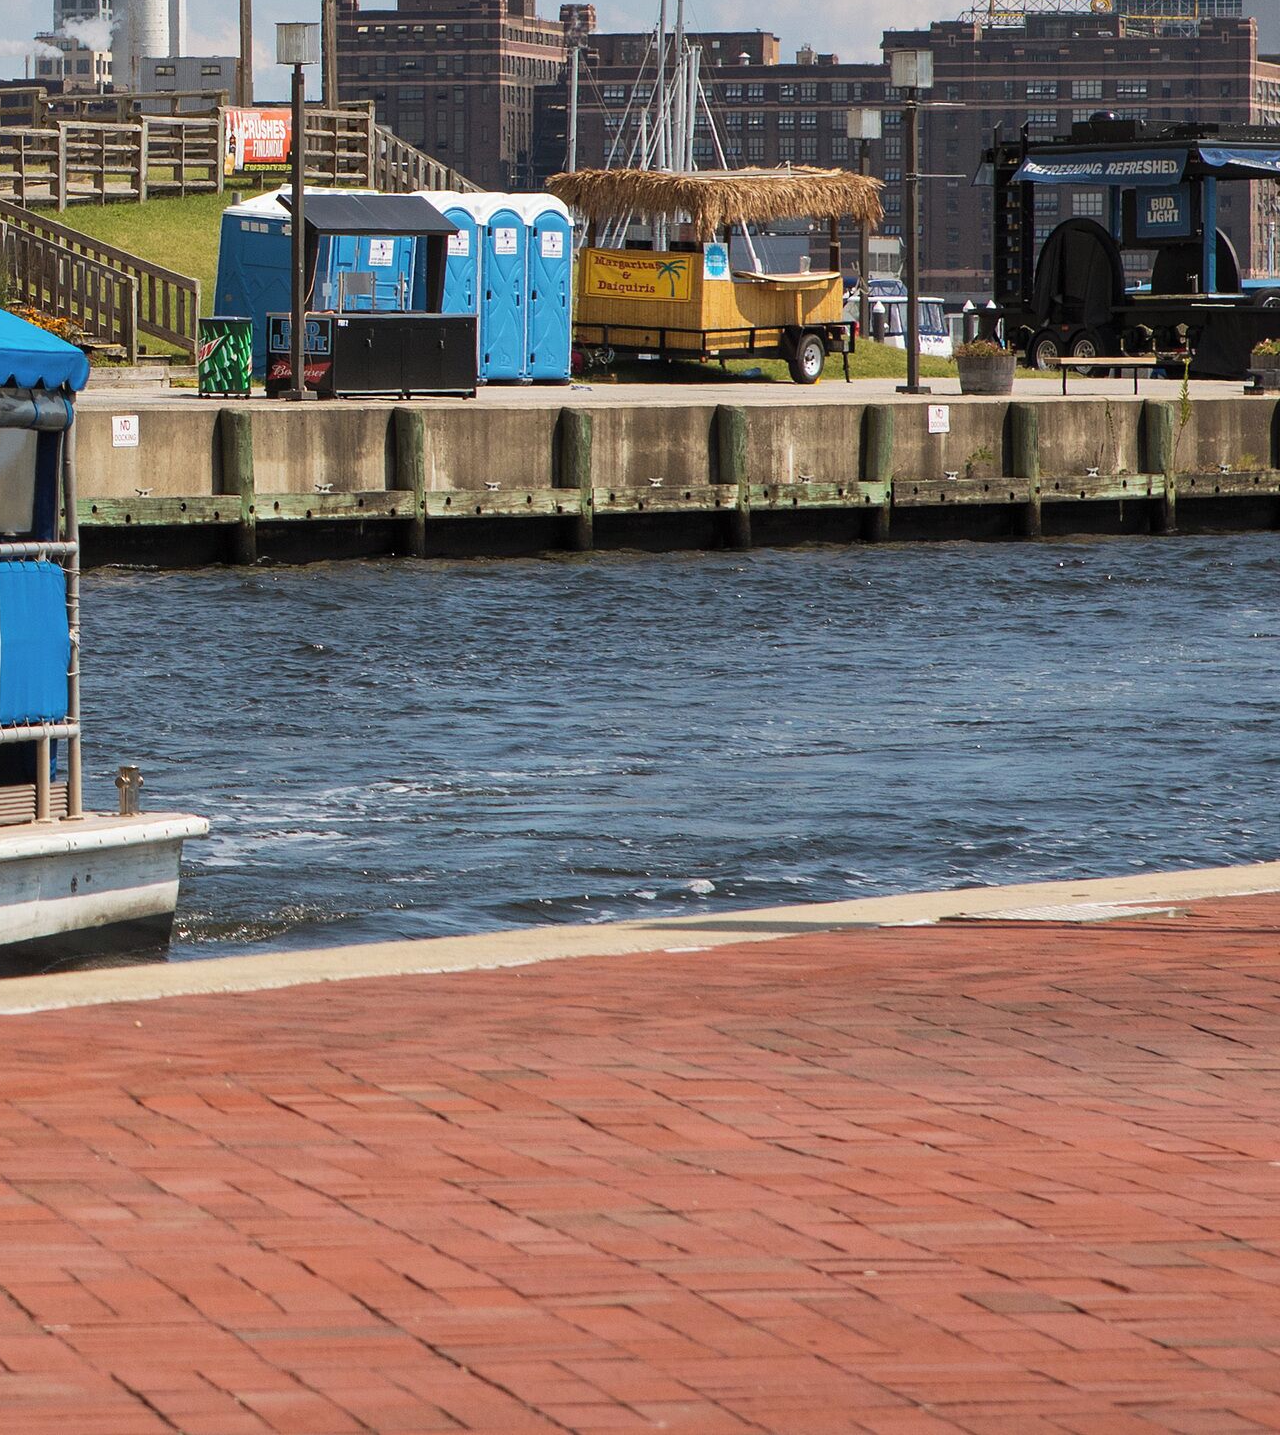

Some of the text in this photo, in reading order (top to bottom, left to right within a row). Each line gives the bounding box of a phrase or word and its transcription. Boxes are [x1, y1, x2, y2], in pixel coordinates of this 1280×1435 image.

[242, 119, 287, 140] CRUSHES
[1105, 159, 1179, 175] REFRESHED.
[1150, 196, 1175, 209] BUD
[1147, 210, 1180, 223] LIGHT
[594, 256, 663, 271] Margaritas
[622, 271, 631, 279] &
[597, 280, 656, 294] Daiquiris
[280, 320, 320, 335] BD
[120, 419, 131, 431] NO
